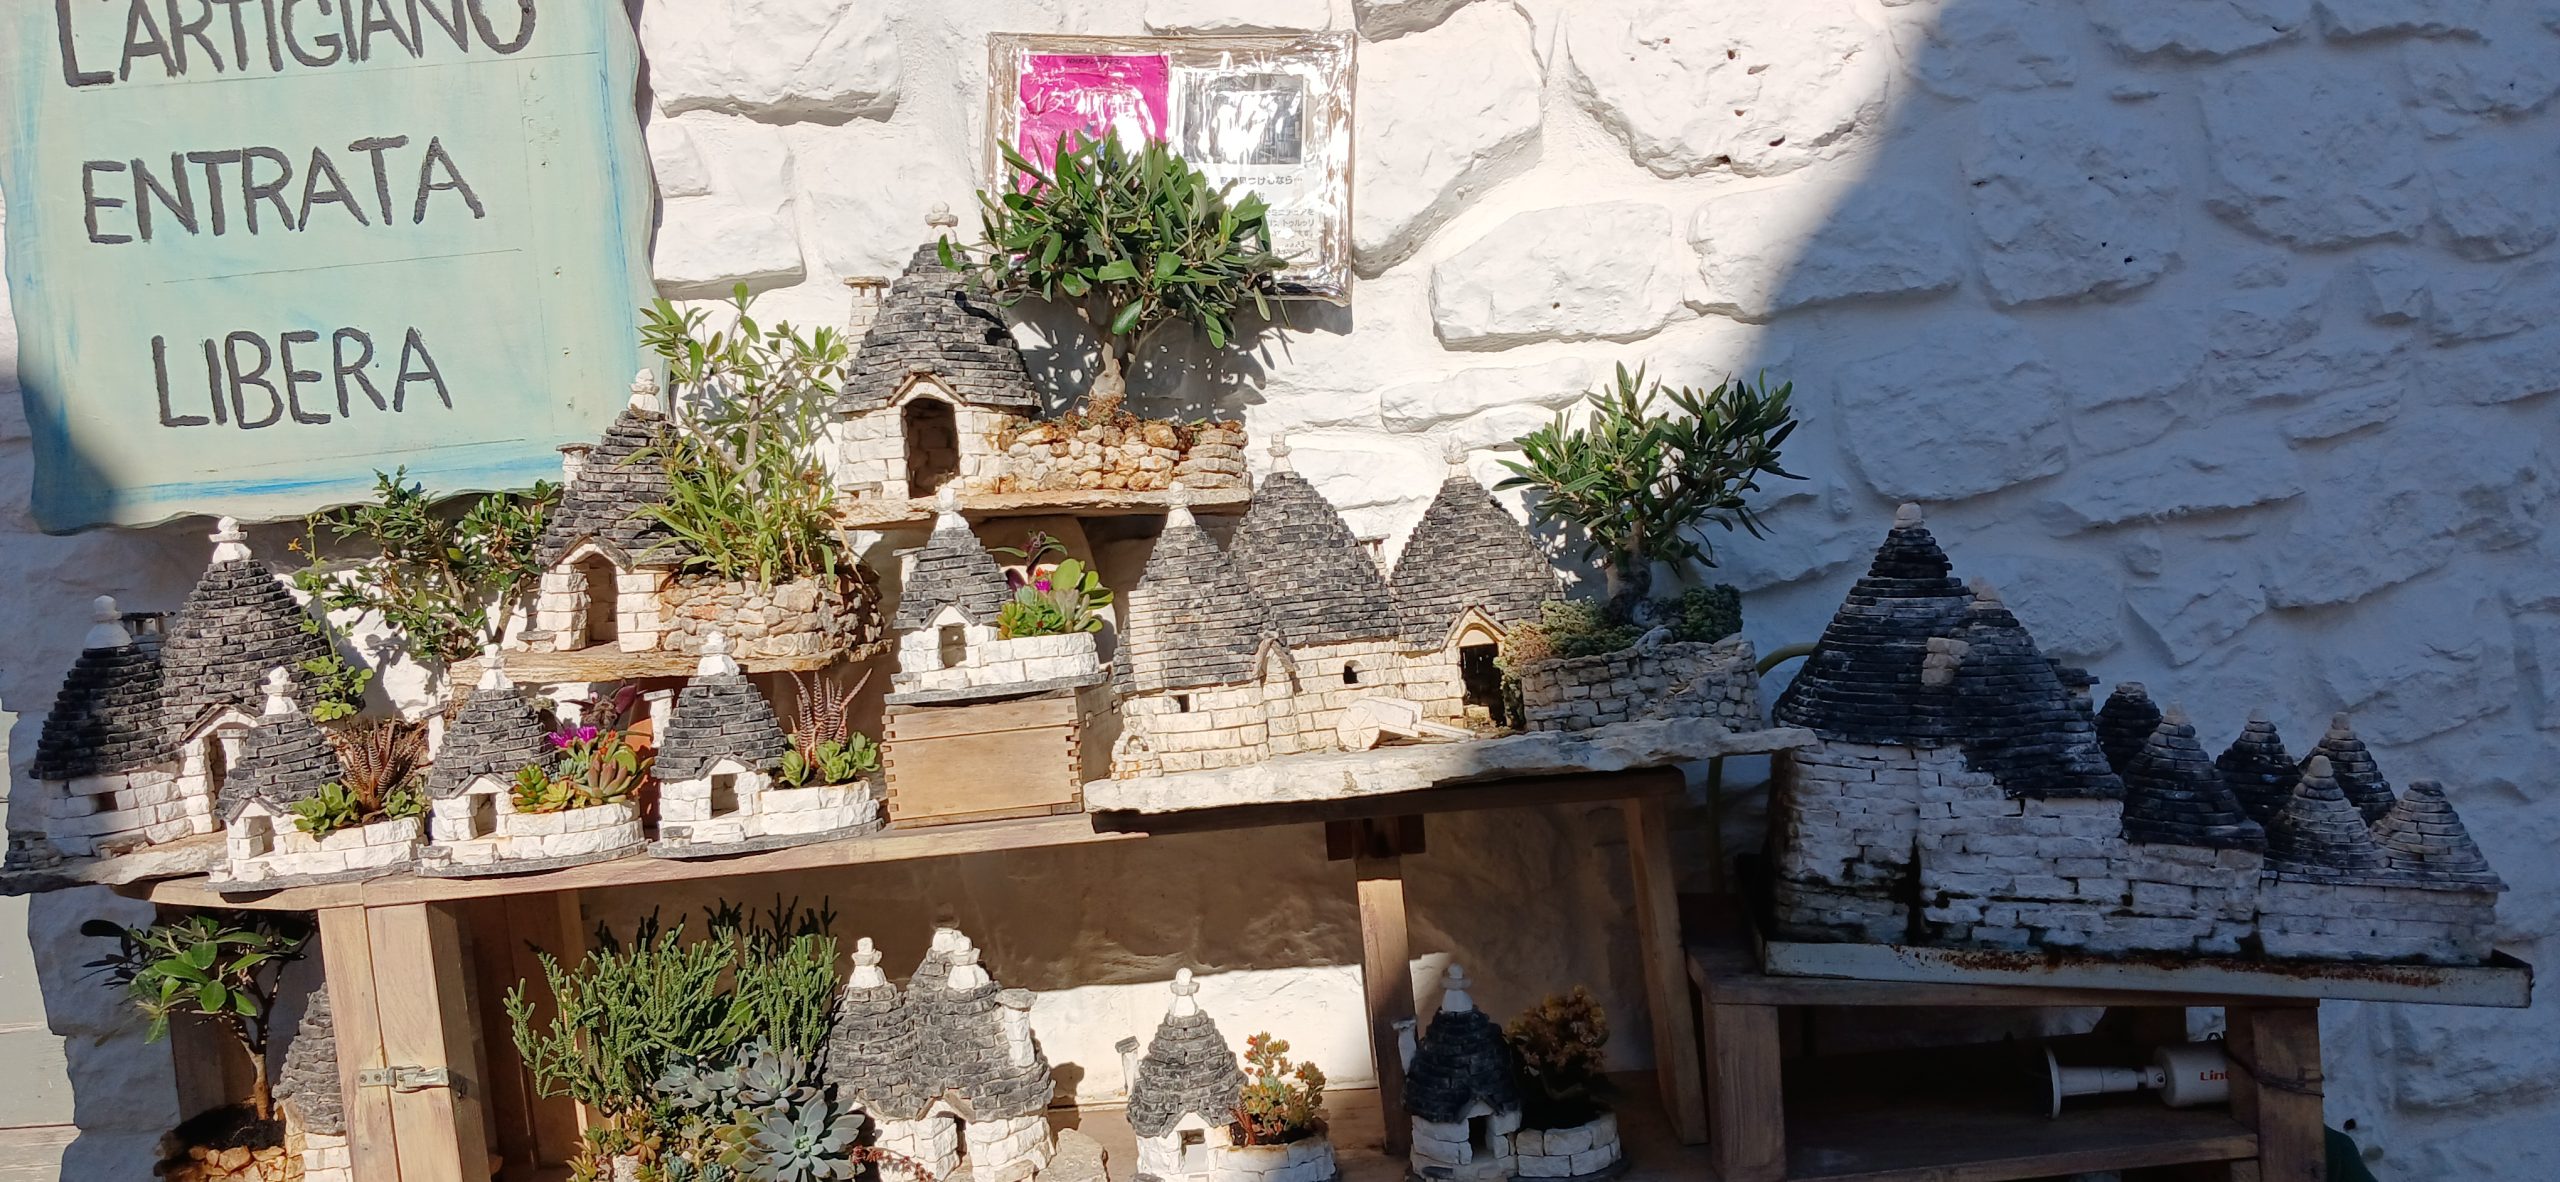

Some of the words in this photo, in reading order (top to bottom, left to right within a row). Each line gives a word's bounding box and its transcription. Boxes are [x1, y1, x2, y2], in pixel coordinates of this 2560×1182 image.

[55, 0, 536, 88] LARTIGIANO
[82, 134, 486, 245] ENTRATA
[151, 326, 453, 430] LIBERA
